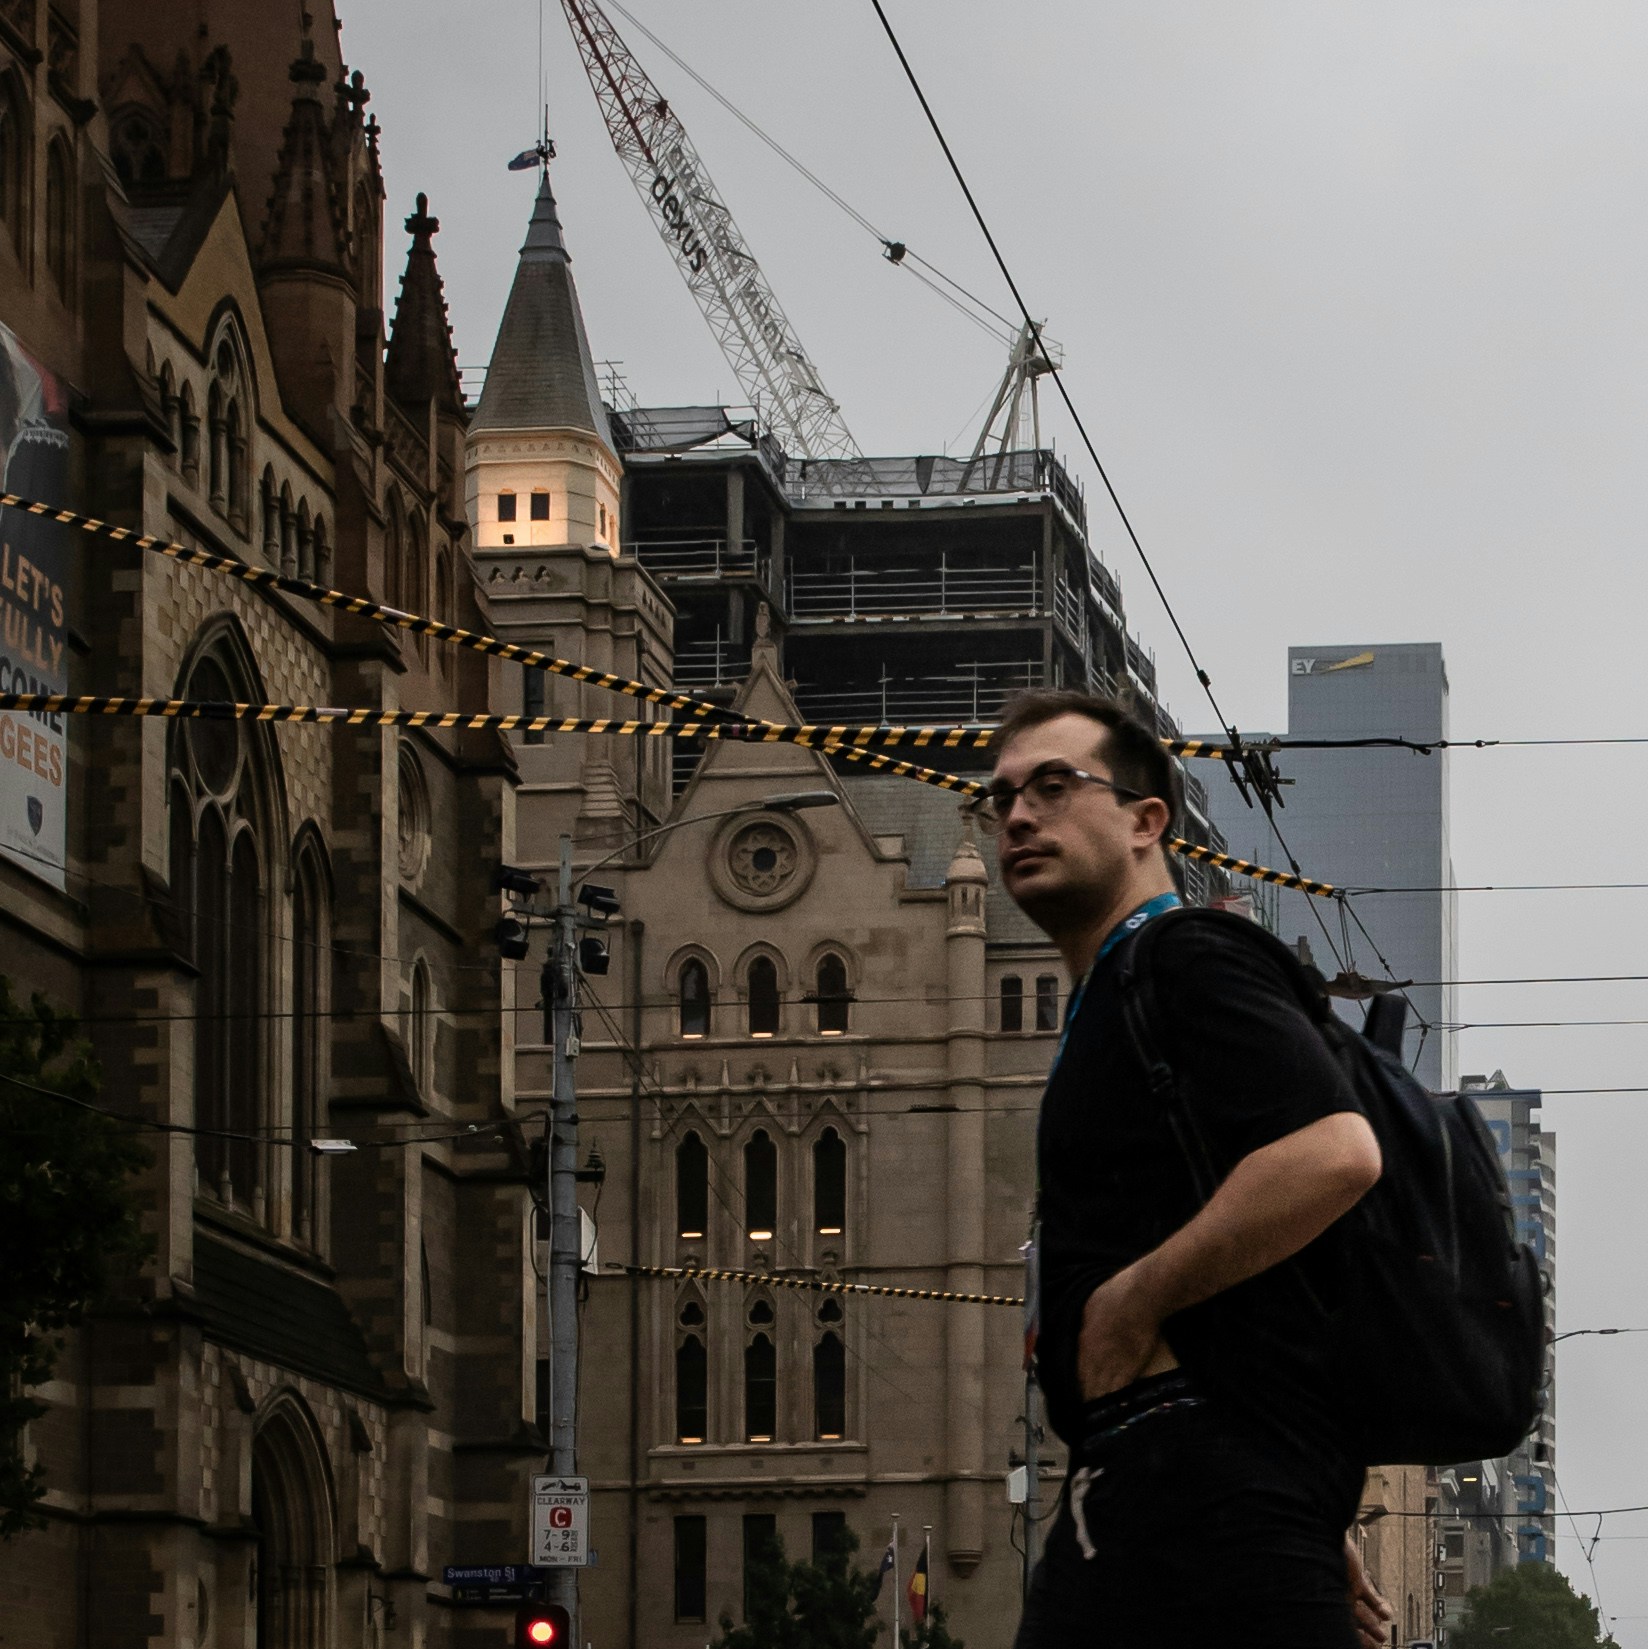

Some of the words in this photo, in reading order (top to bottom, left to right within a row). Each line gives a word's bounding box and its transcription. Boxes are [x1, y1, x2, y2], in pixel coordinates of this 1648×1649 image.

[653, 175, 708, 272] dexus
[2, 542, 64, 628] LET'S
[1292, 659, 1316, 674] EY
[0, 714, 62, 786] GEES
[537, 1497, 585, 1506] CLEARWAY
[554, 1509, 567, 1526] C
[539, 1555, 558, 1563] MON
[568, 1555, 582, 1563] FRI
[448, 1567, 502, 1579] Swanston
